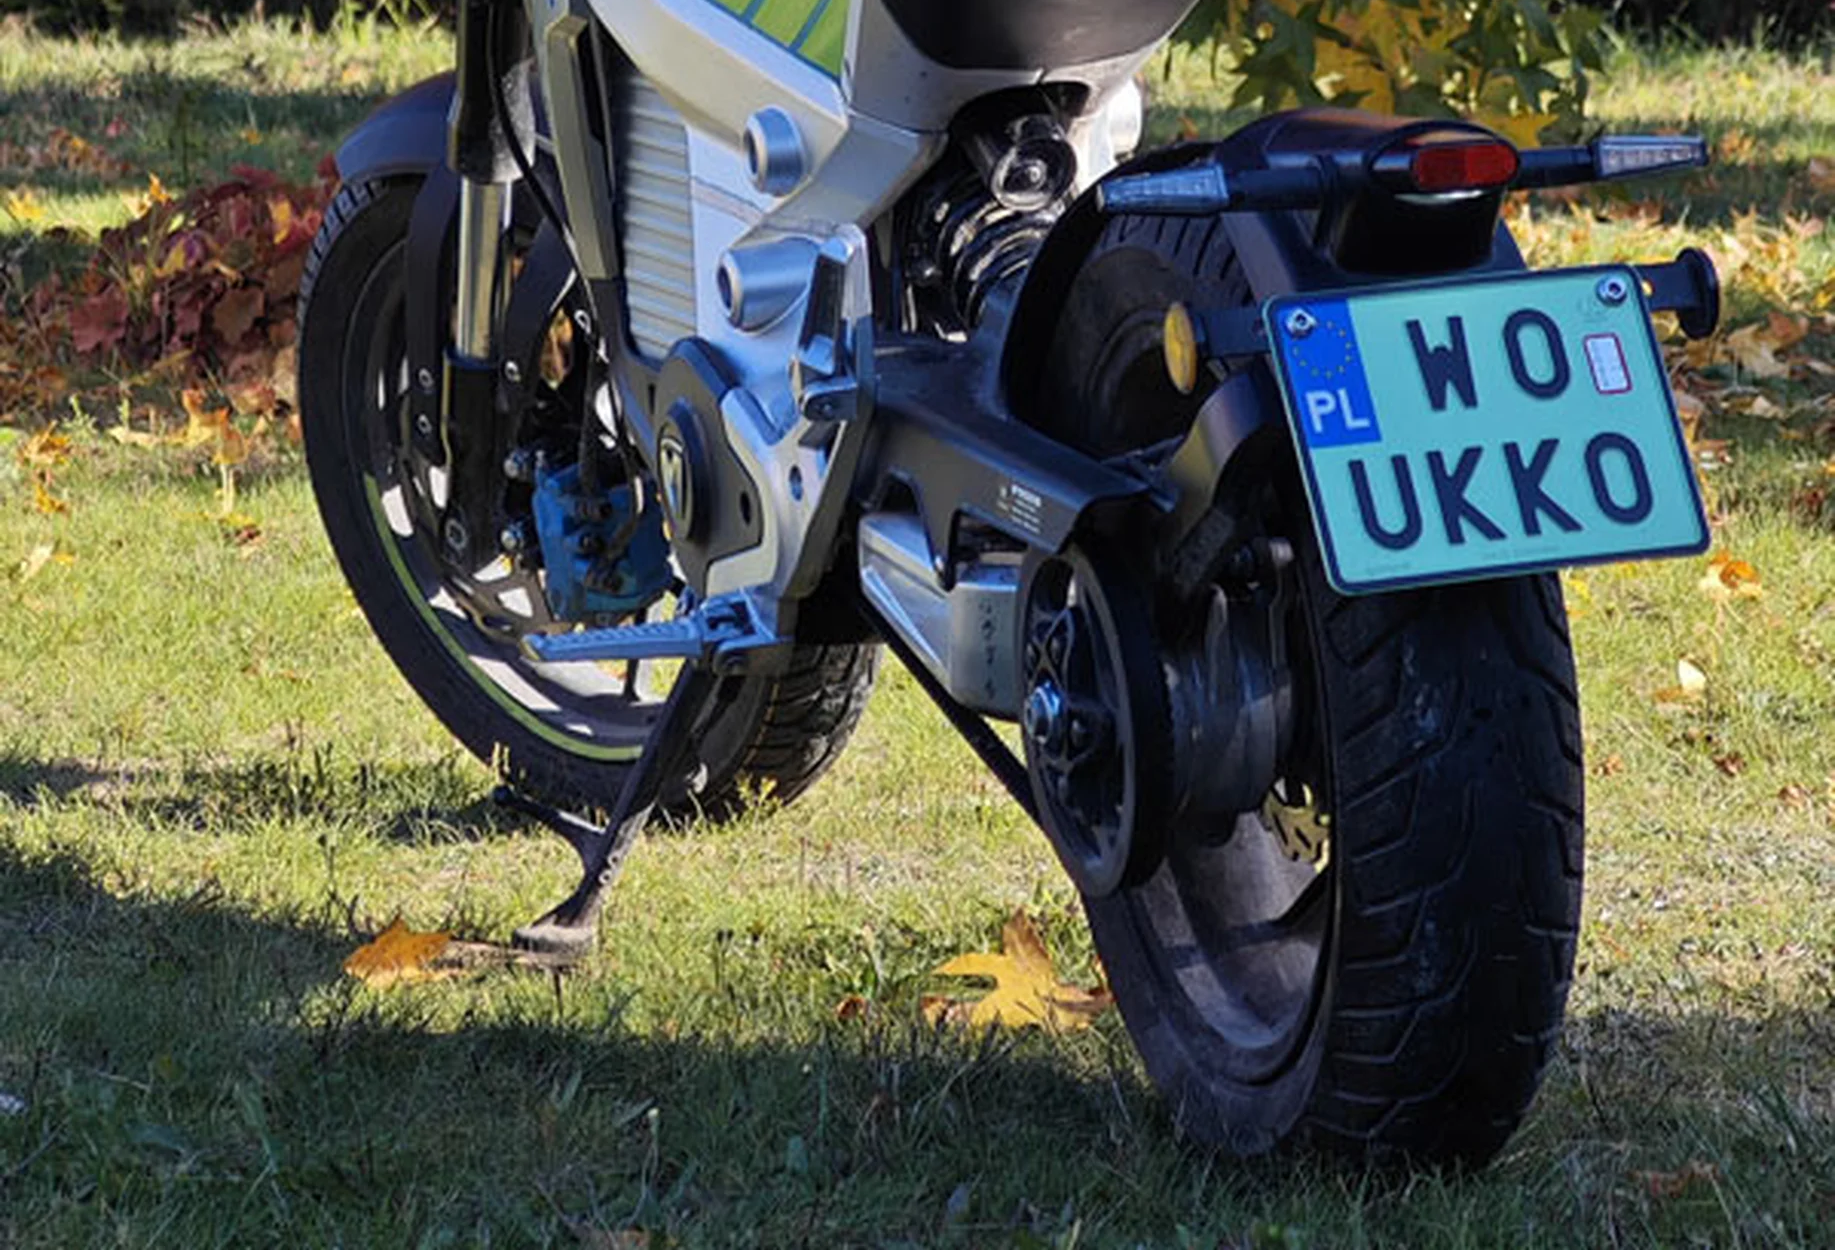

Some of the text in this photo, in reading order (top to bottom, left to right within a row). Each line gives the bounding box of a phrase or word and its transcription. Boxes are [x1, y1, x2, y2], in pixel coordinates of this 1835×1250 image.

[1305, 389, 1370, 433] PL
[1405, 308, 1571, 412] WO
[1347, 431, 1654, 551] UKKO
